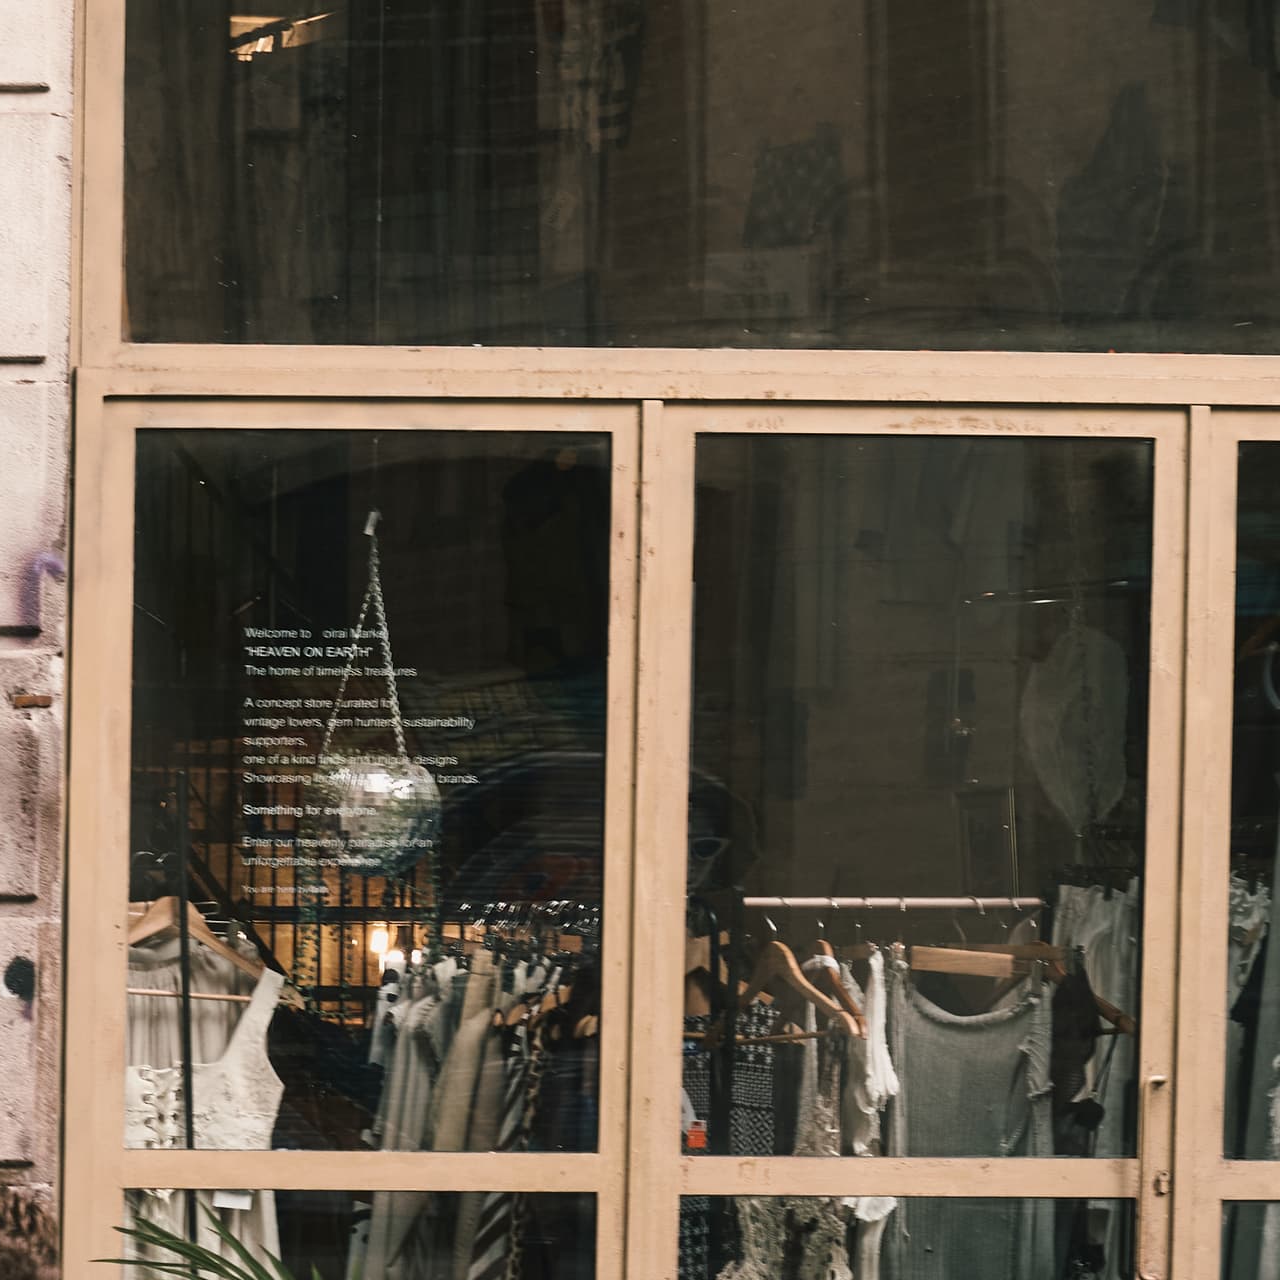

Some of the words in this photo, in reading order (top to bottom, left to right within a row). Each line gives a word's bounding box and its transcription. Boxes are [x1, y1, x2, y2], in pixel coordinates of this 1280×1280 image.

[244, 627, 298, 638] Welcome
[299, 628, 312, 638] to
[349, 627, 389, 638] Marke
[303, 646, 323, 657] ON
[244, 664, 267, 676] The
[268, 664, 300, 676] home
[302, 664, 315, 676] of
[243, 697, 254, 708] A
[255, 697, 303, 710] concept
[304, 697, 333, 708] store
[379, 697, 397, 708] fo
[244, 717, 286, 729] vintage
[401, 716, 476, 730] sustainability
[243, 736, 308, 747] supporters,
[243, 755, 265, 765] one
[267, 753, 281, 765] of
[291, 753, 316, 765] kind
[413, 753, 459, 767] designs
[243, 771, 311, 785] Showcasing
[242, 804, 304, 817] Something
[305, 805, 322, 815] for
[242, 836, 272, 847] Enter
[275, 838, 294, 847] our
[296, 836, 345, 850] heavenly
[242, 856, 317, 868] unforgettable
